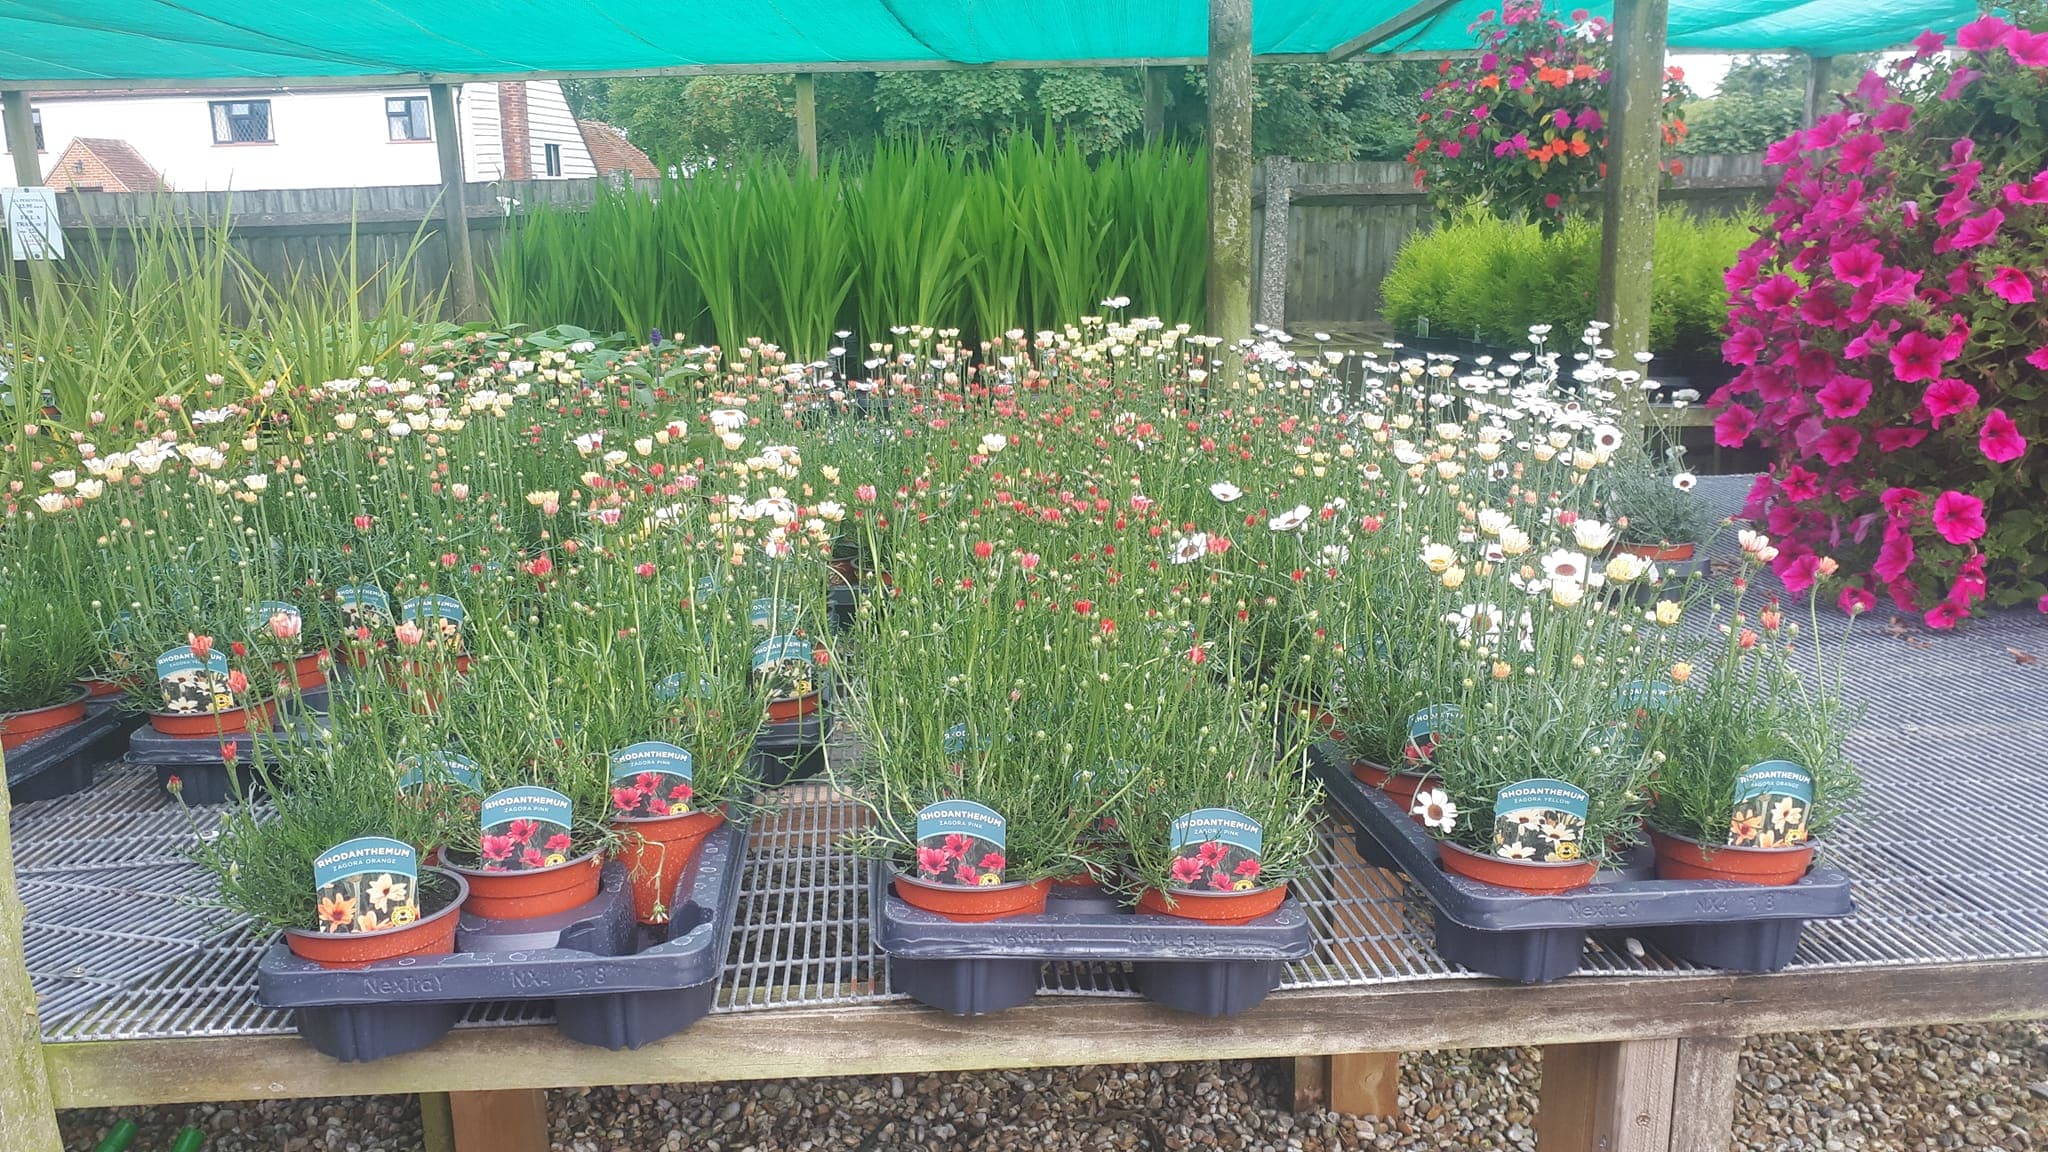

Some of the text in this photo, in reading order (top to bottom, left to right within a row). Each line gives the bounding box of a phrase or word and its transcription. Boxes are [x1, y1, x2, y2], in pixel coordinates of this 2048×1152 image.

[159, 652, 222, 665] RHODANTUM
[1739, 771, 1812, 785] RHODANTHEMUM
[1501, 787, 1585, 802] RHODANTHEMUM
[1544, 797, 1571, 805] YELLOW
[484, 796, 569, 810] RHODANTHEMUM
[920, 810, 1002, 828] RHODANTHEMUM
[968, 821, 983, 829] PINK
[1175, 819, 1259, 834] RHODANTHEMUM
[317, 847, 410, 869] RHODANTHEMUM
[333, 858, 396, 872] ZAGORA ORANGE
